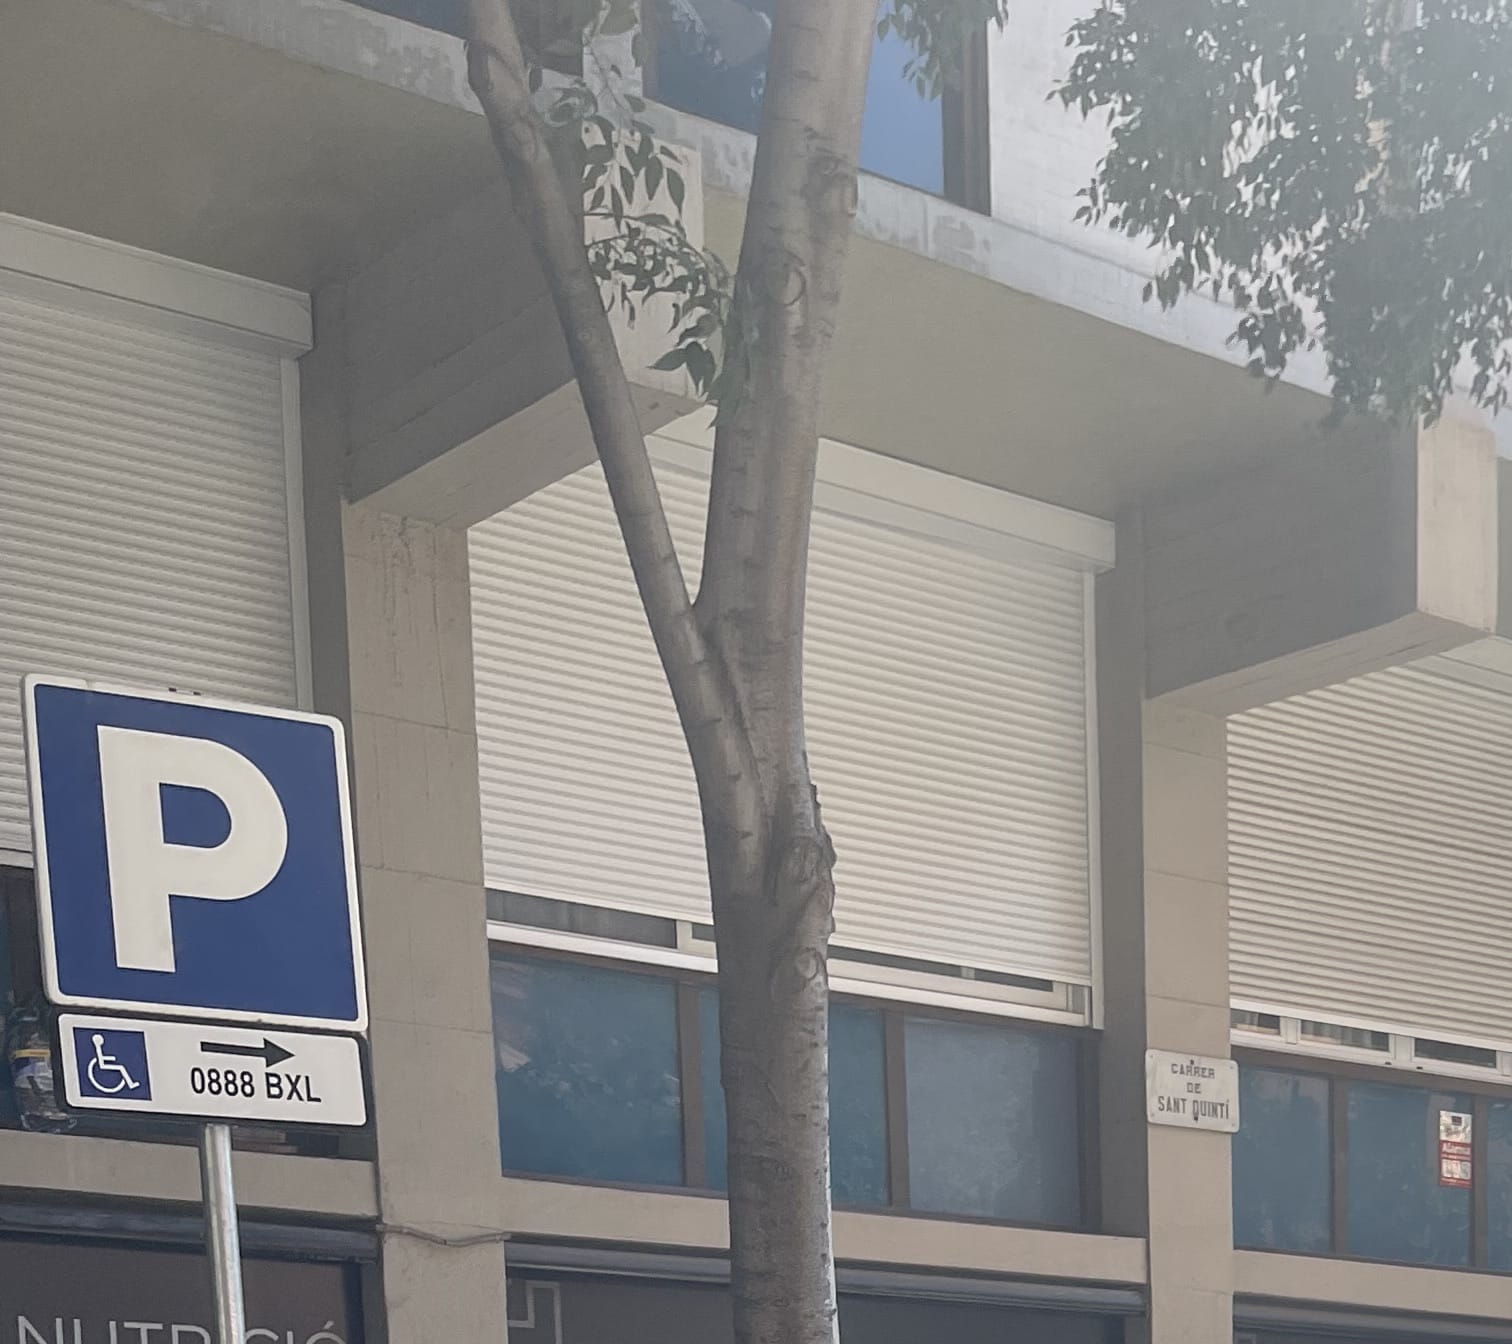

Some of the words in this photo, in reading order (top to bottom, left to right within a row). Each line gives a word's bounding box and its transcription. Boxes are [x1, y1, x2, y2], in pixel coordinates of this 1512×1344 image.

[97, 724, 288, 973] P
[1170, 1063, 1215, 1079] CARRER
[191, 1067, 255, 1097] 0888
[265, 1072, 322, 1102] BXL
[1186, 1082, 1202, 1094] DE
[1158, 1095, 1187, 1114] SANT
